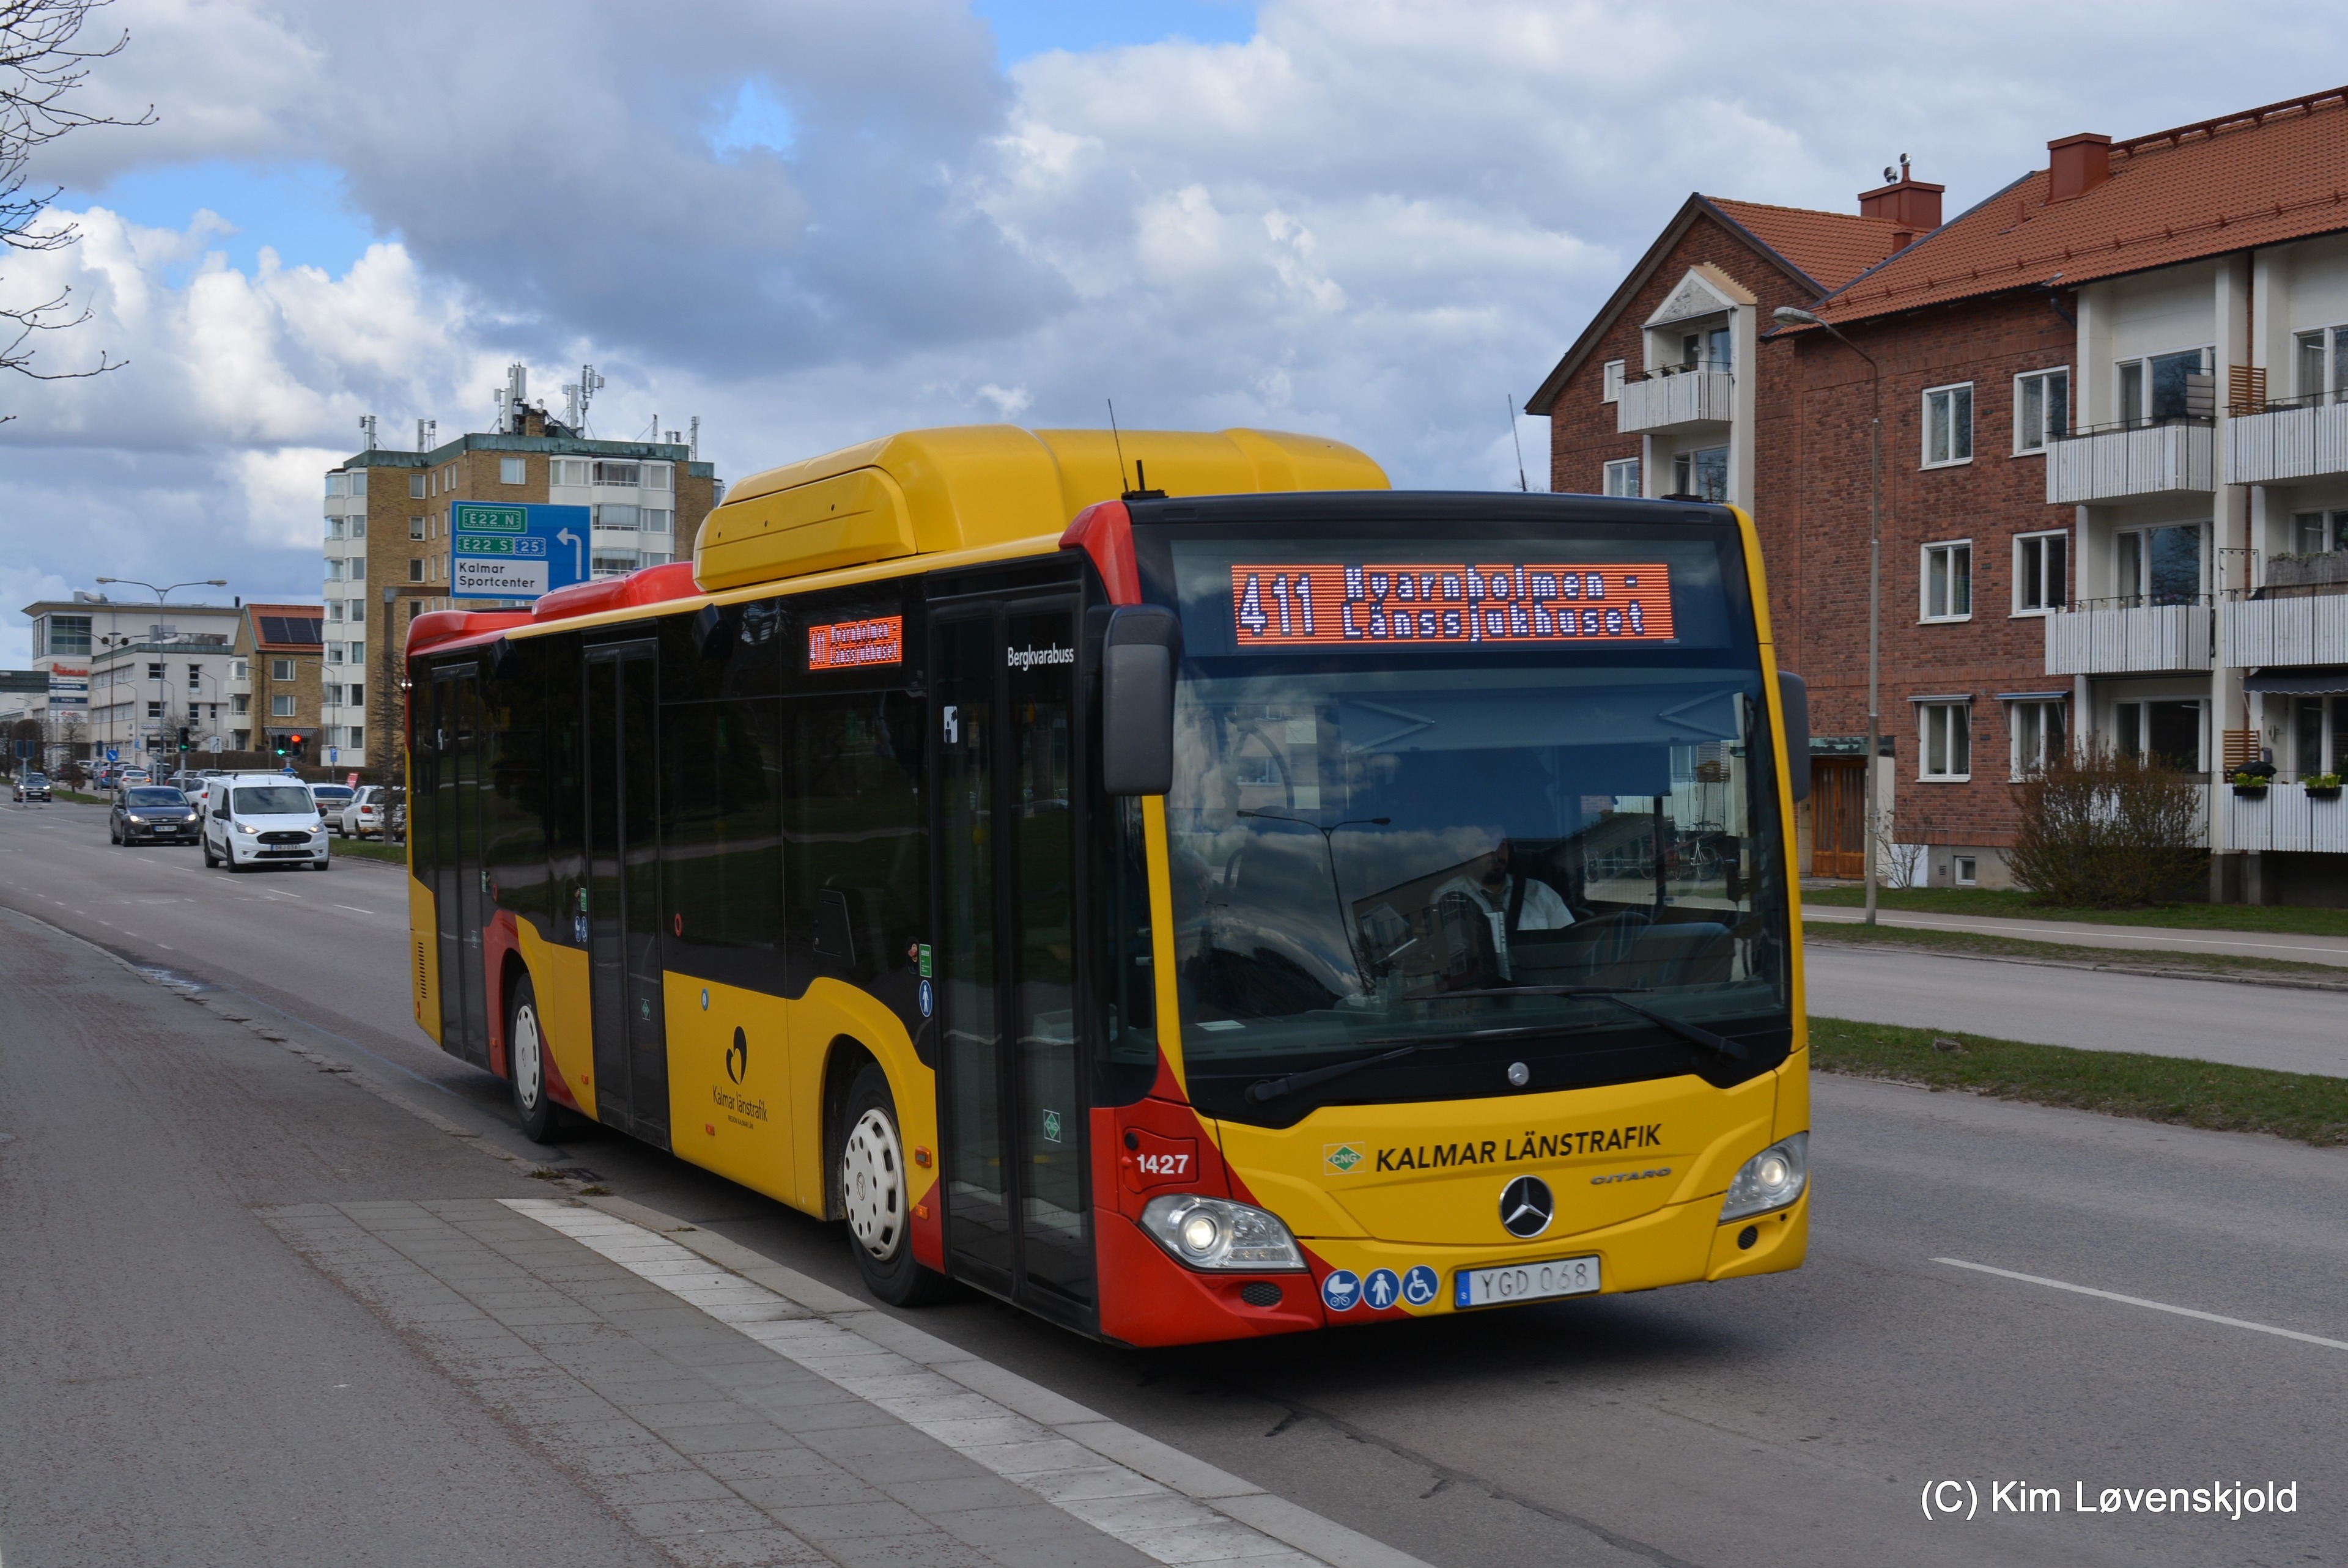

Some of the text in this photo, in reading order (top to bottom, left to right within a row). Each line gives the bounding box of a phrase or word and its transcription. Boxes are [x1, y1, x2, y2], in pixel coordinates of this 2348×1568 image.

[469, 513, 514, 526] E22 N
[463, 539, 508, 551] E22 S
[520, 541, 539, 552] 25
[459, 562, 506, 574] Kalmar
[459, 575, 536, 589] Sportcenter
[1241, 577, 1313, 632] 411
[1343, 603, 1643, 642] Länssjukhuset
[809, 632, 825, 663] 411
[1007, 642, 1074, 672] Bergkvarabuss
[712, 1084, 768, 1122] Kalmar länstrafik
[1376, 1122, 1663, 1172] KALMAR LÄNSTRAFIK
[1136, 1154, 1189, 1174] 1427
[1332, 1153, 1357, 1165] CNG
[1590, 1166, 1672, 1185] CITARO
[1480, 1262, 1588, 1299] YGD 068
